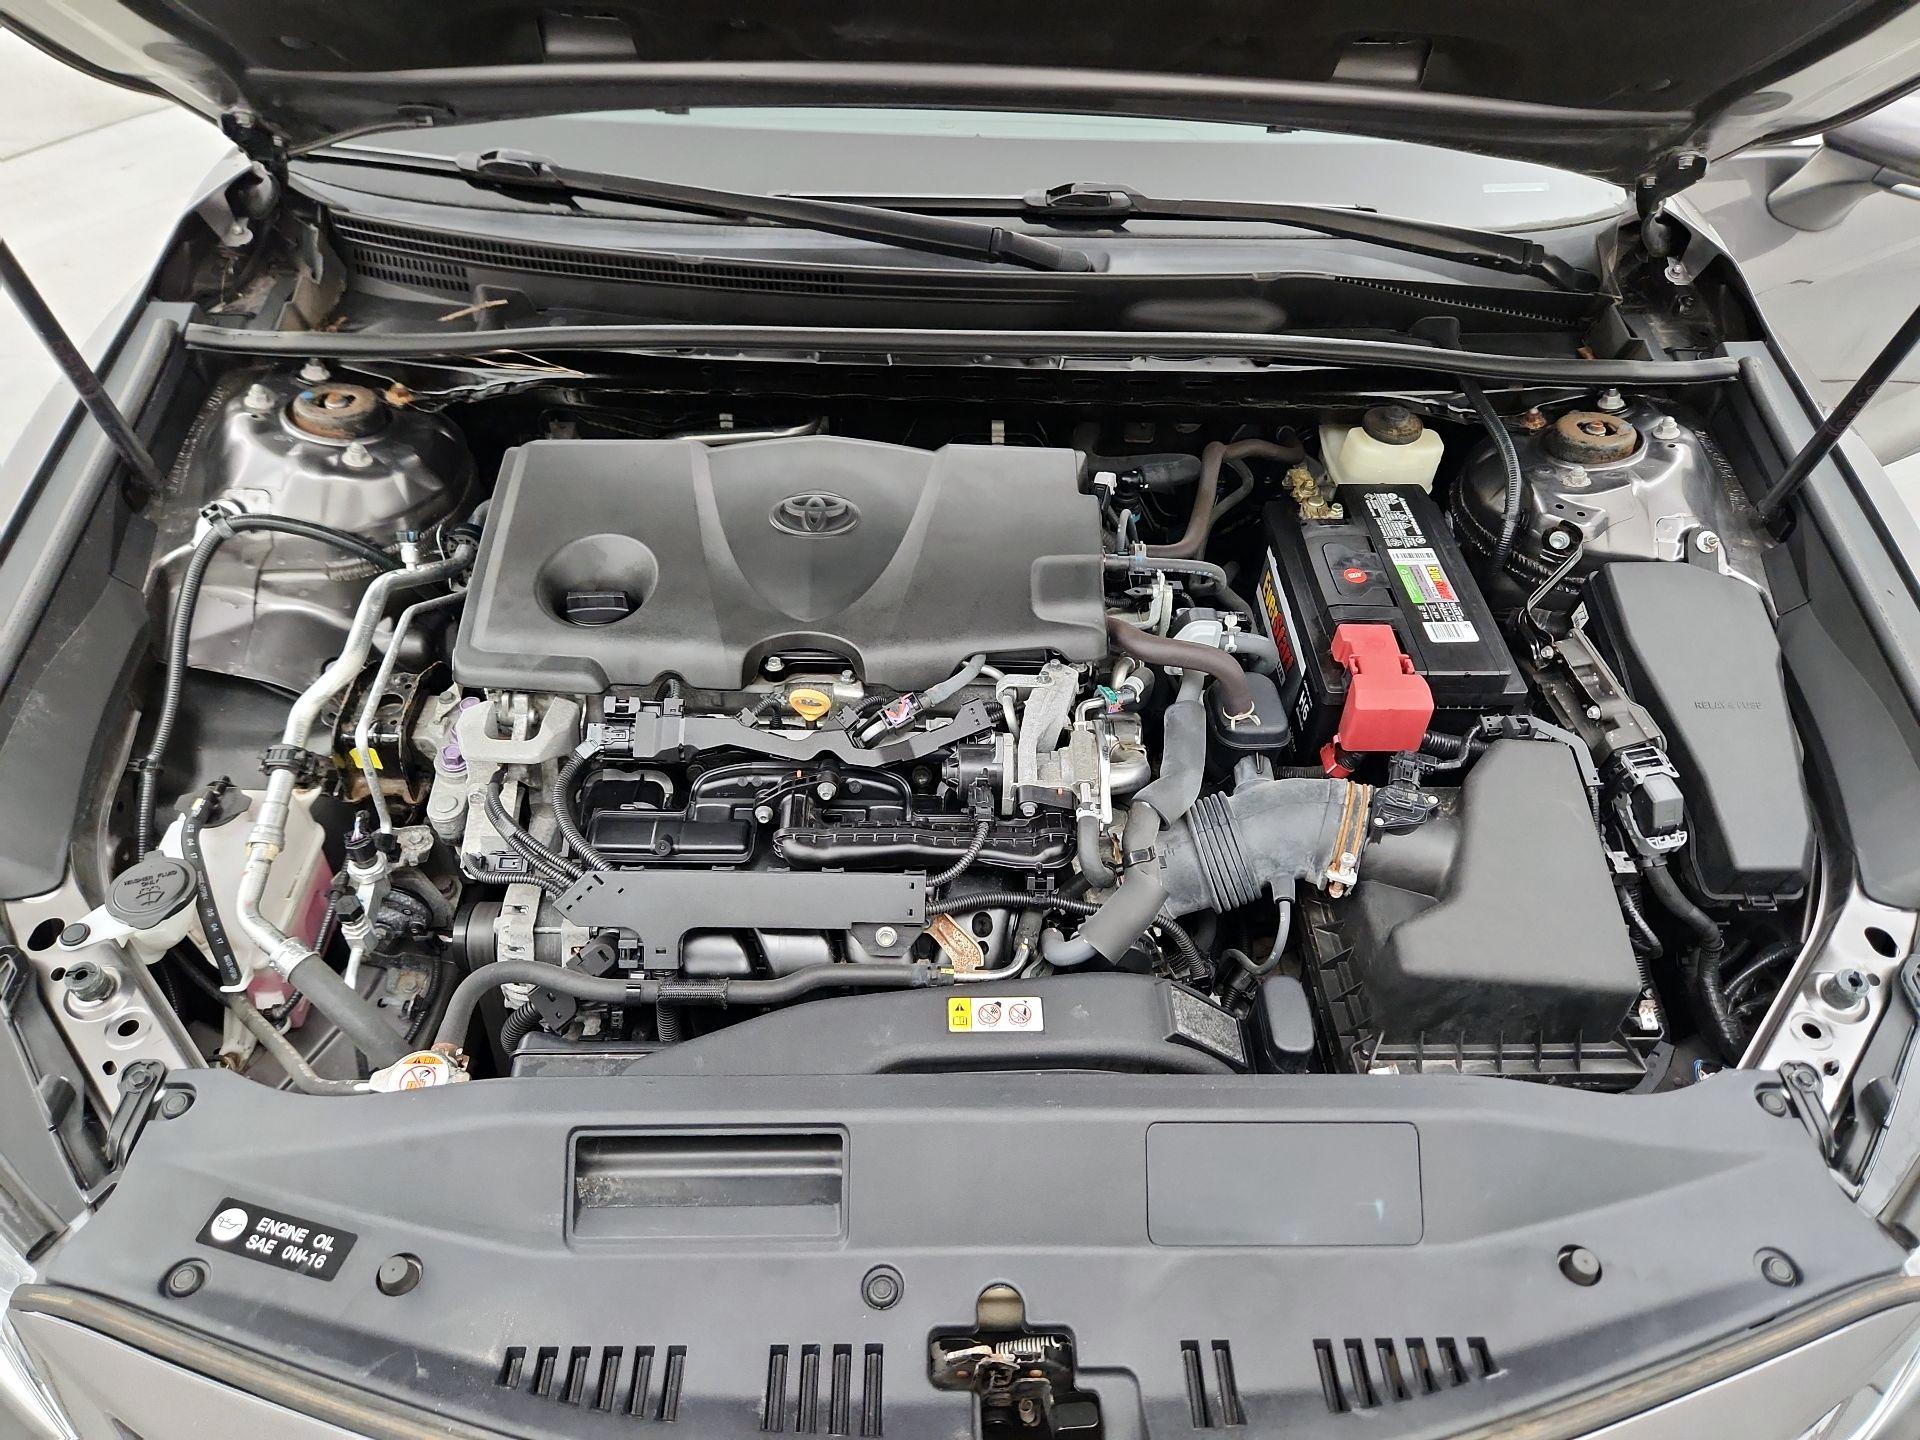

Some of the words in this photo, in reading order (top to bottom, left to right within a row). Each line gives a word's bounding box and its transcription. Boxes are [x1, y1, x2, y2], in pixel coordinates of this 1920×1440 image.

[256, 1217, 310, 1243] ENGINE
[313, 1233, 335, 1252] OIL
[245, 1235, 278, 1255] SAE
[281, 1245, 327, 1269] 0W-16
